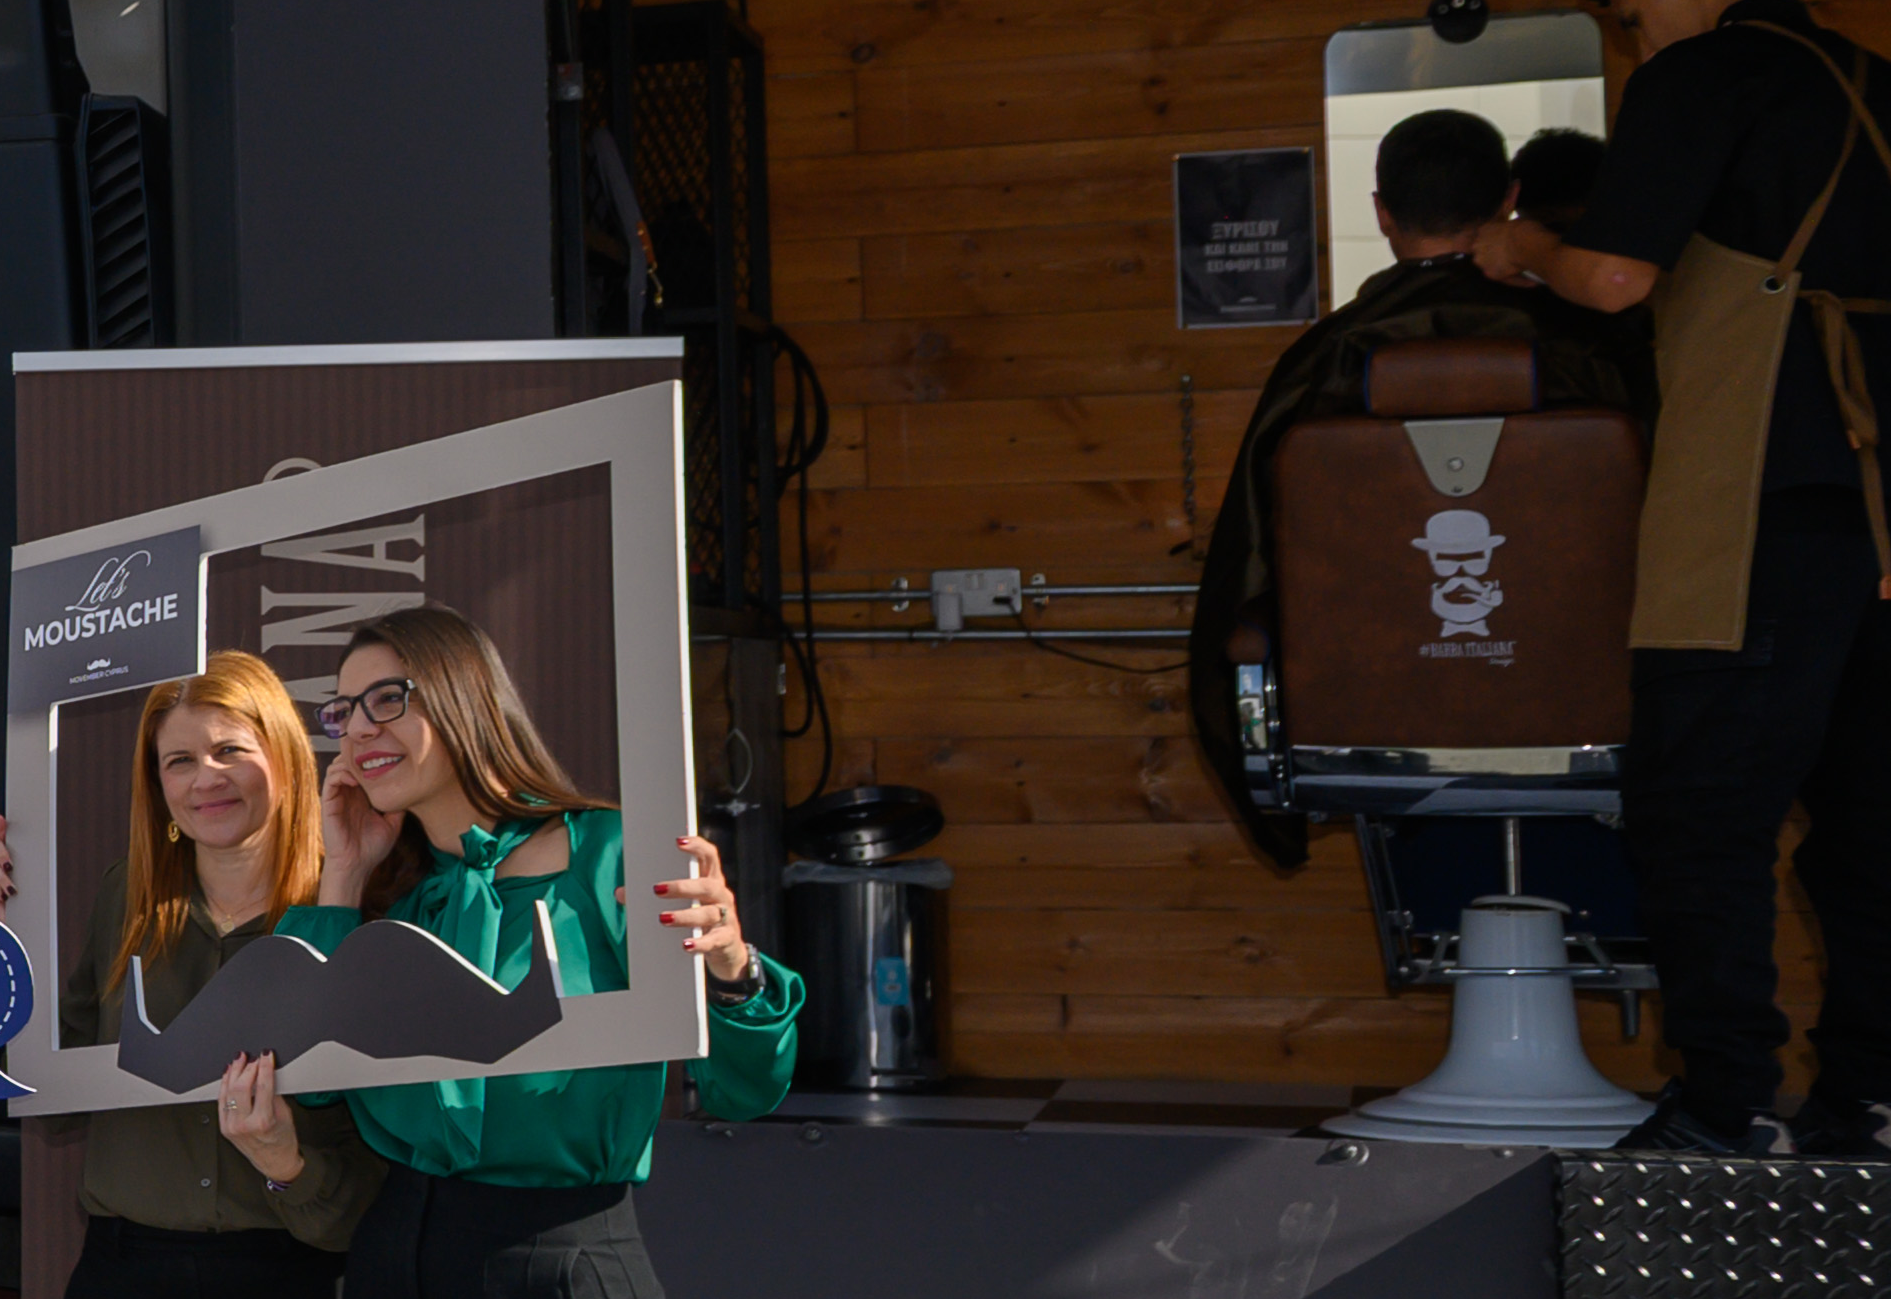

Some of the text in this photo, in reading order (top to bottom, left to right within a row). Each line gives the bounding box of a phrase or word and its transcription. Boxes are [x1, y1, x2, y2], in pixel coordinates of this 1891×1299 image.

[65, 549, 152, 612] Let's
[24, 593, 179, 652] MOUSTACHE
[69, 665, 130, 684] MOVEMBER CYPRUS
